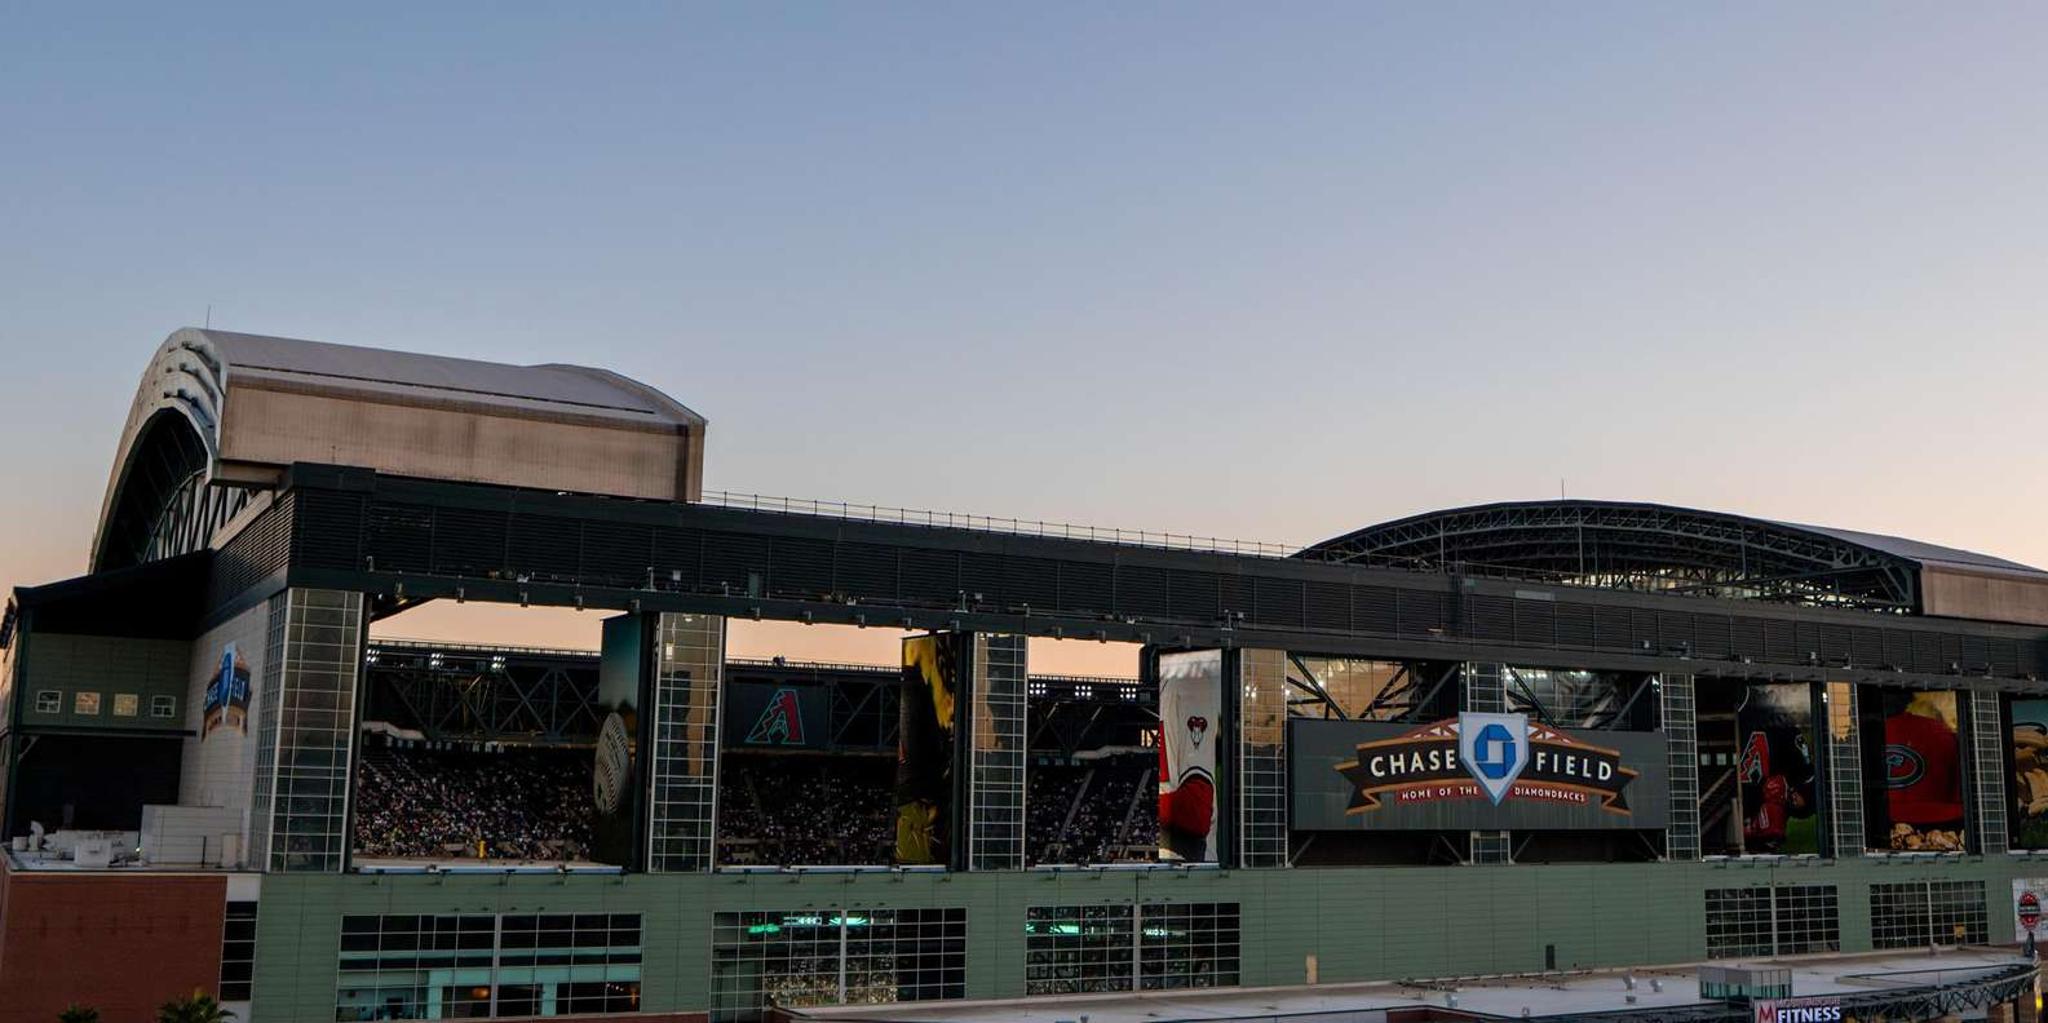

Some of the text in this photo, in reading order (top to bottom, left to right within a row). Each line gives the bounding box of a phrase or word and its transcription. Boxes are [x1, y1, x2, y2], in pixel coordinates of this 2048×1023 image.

[1370, 749, 1612, 781] CHASE FIELD
[1402, 785, 1585, 802] HOME OF THE DIAMONDBACKS
[1777, 1006, 1841, 1023] FITNESS
